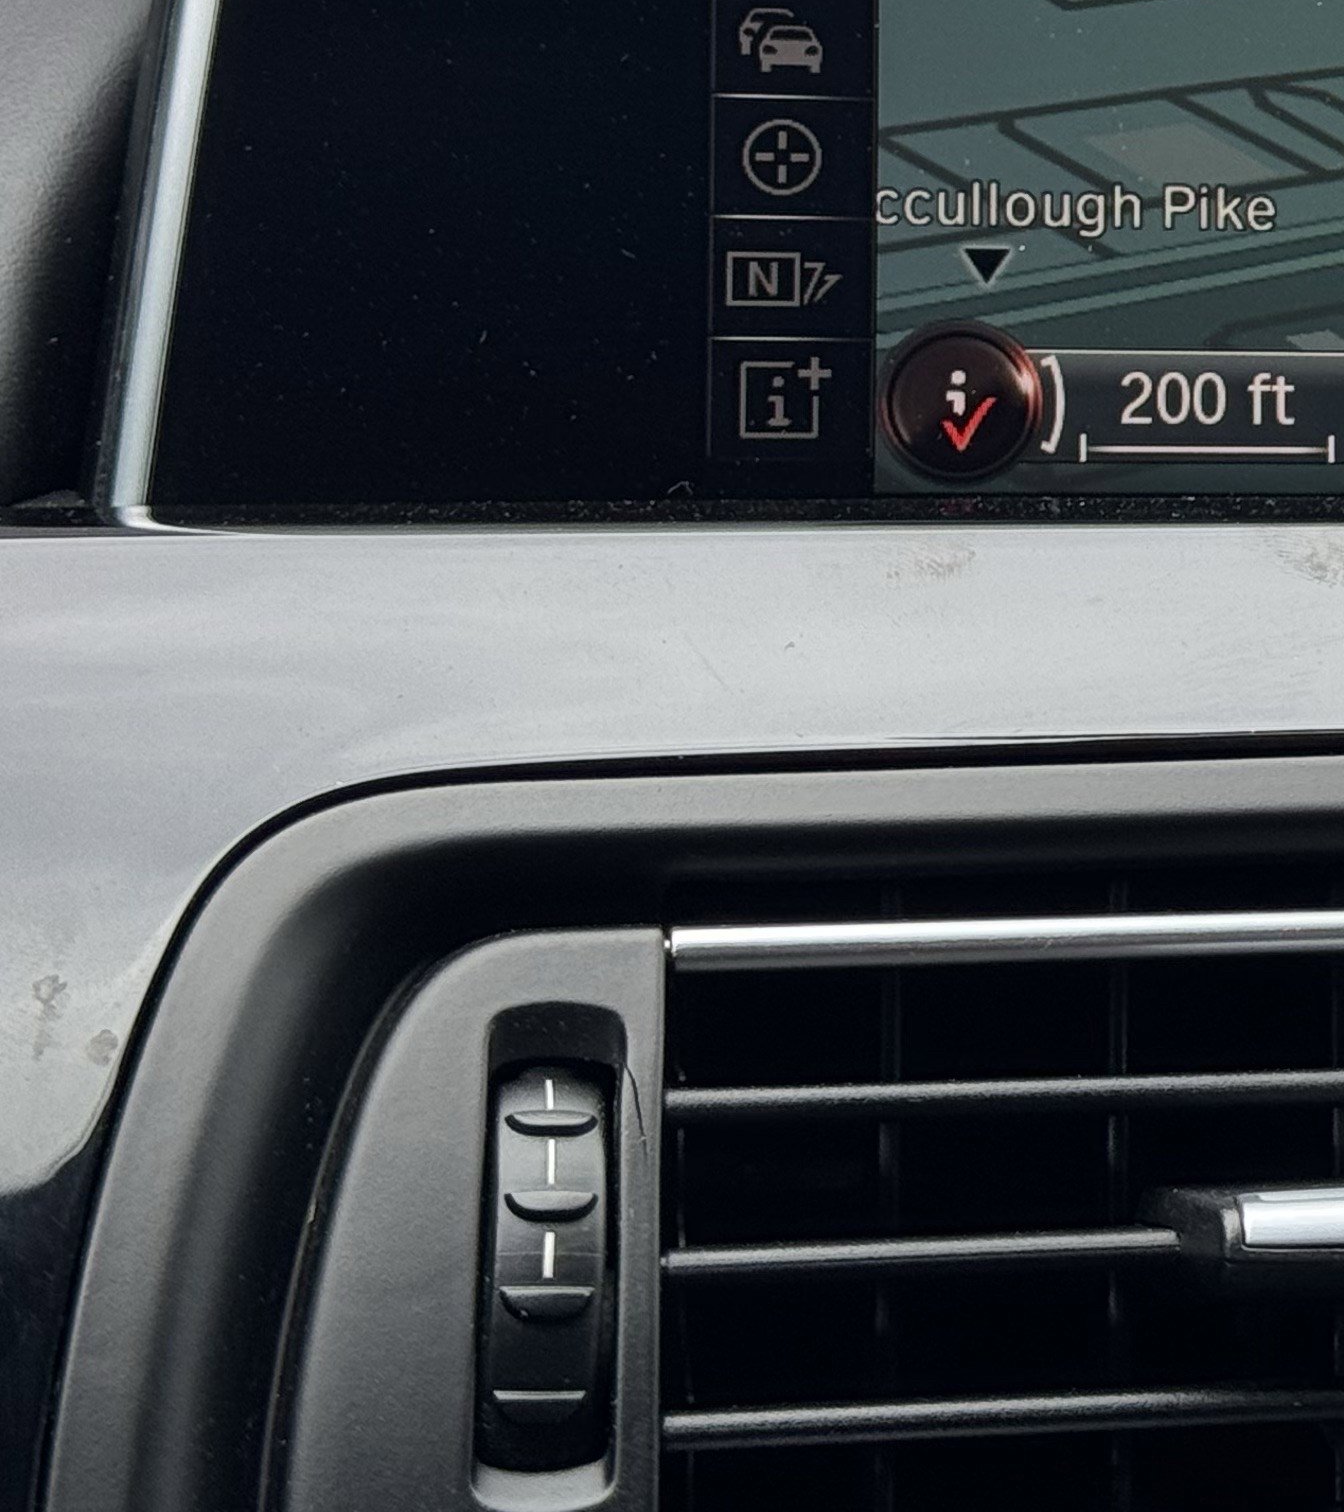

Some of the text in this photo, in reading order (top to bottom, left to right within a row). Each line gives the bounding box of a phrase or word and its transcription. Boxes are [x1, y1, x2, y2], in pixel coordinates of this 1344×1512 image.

[875, 180, 1277, 237] ccullough Pike
[1119, 371, 1296, 427] 200 ft
